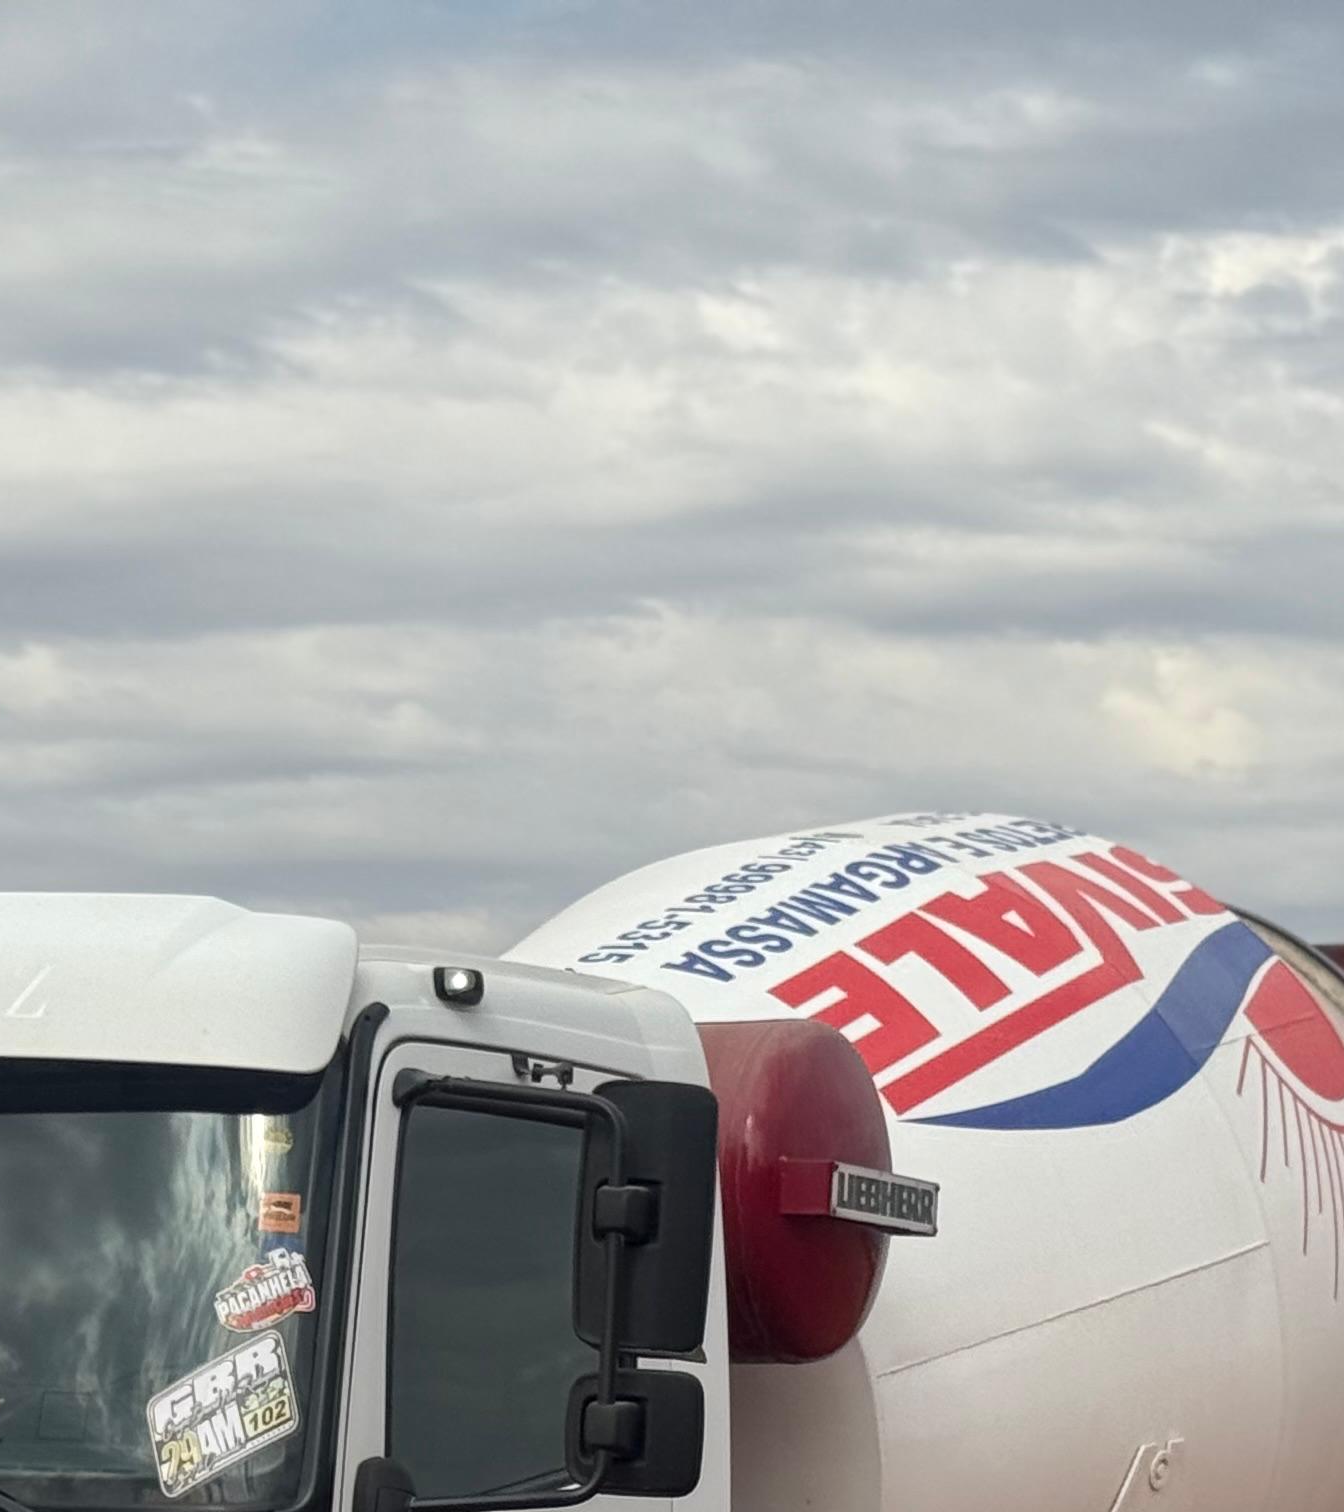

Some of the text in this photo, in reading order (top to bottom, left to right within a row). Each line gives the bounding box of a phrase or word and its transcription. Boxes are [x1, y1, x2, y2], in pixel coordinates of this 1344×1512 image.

[922, 836, 994, 858] E
[660, 841, 960, 982] ARGAMASSA
[836, 1171, 935, 1226] LIEBHERR
[248, 1399, 288, 1432] 102
